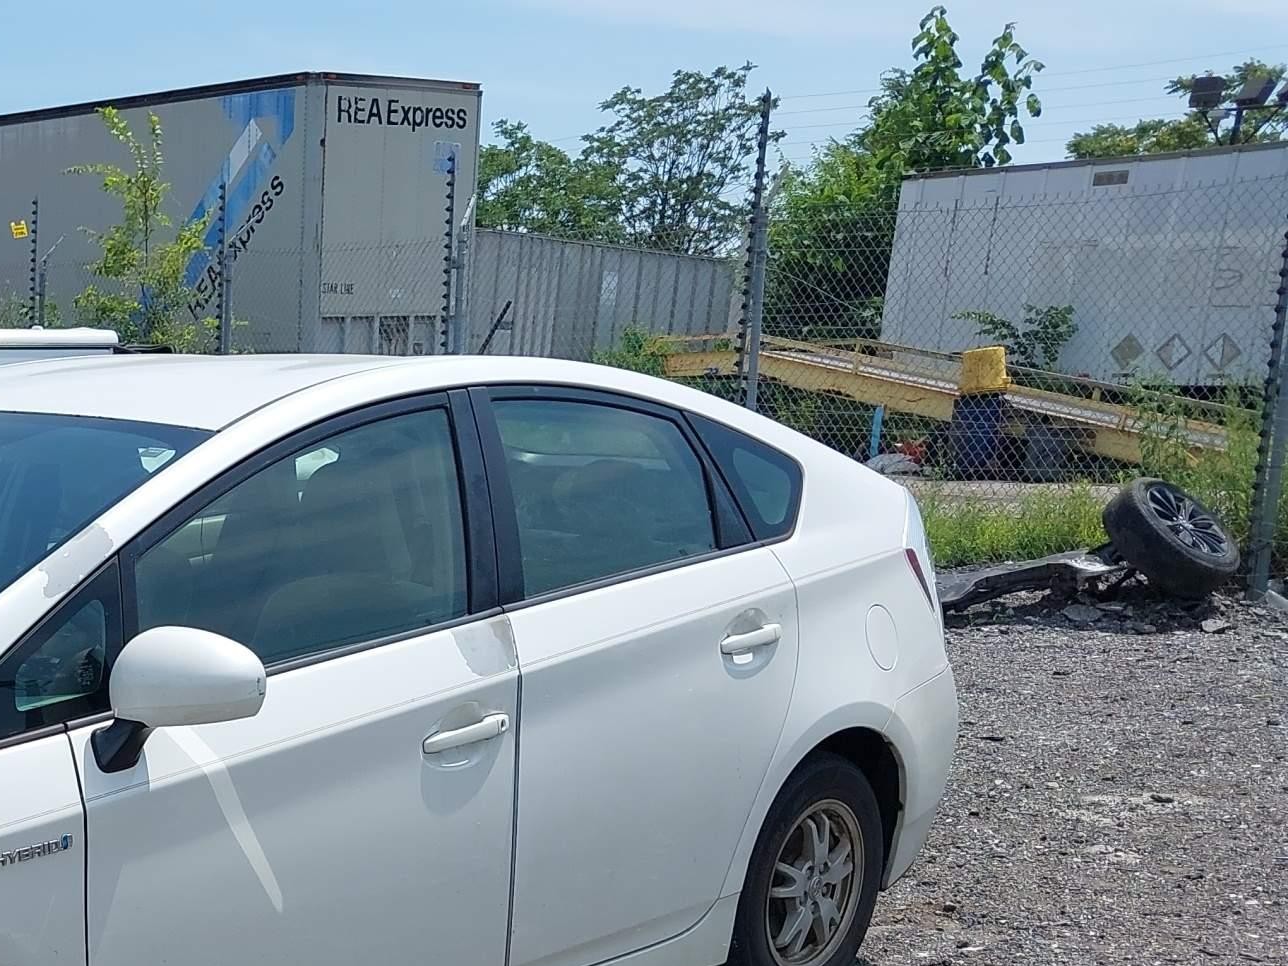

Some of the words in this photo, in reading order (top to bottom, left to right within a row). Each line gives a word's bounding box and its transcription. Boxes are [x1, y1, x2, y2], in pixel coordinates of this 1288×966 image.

[337, 95, 383, 125] REA
[386, 99, 467, 132] Express
[218, 175, 284, 268] xpress
